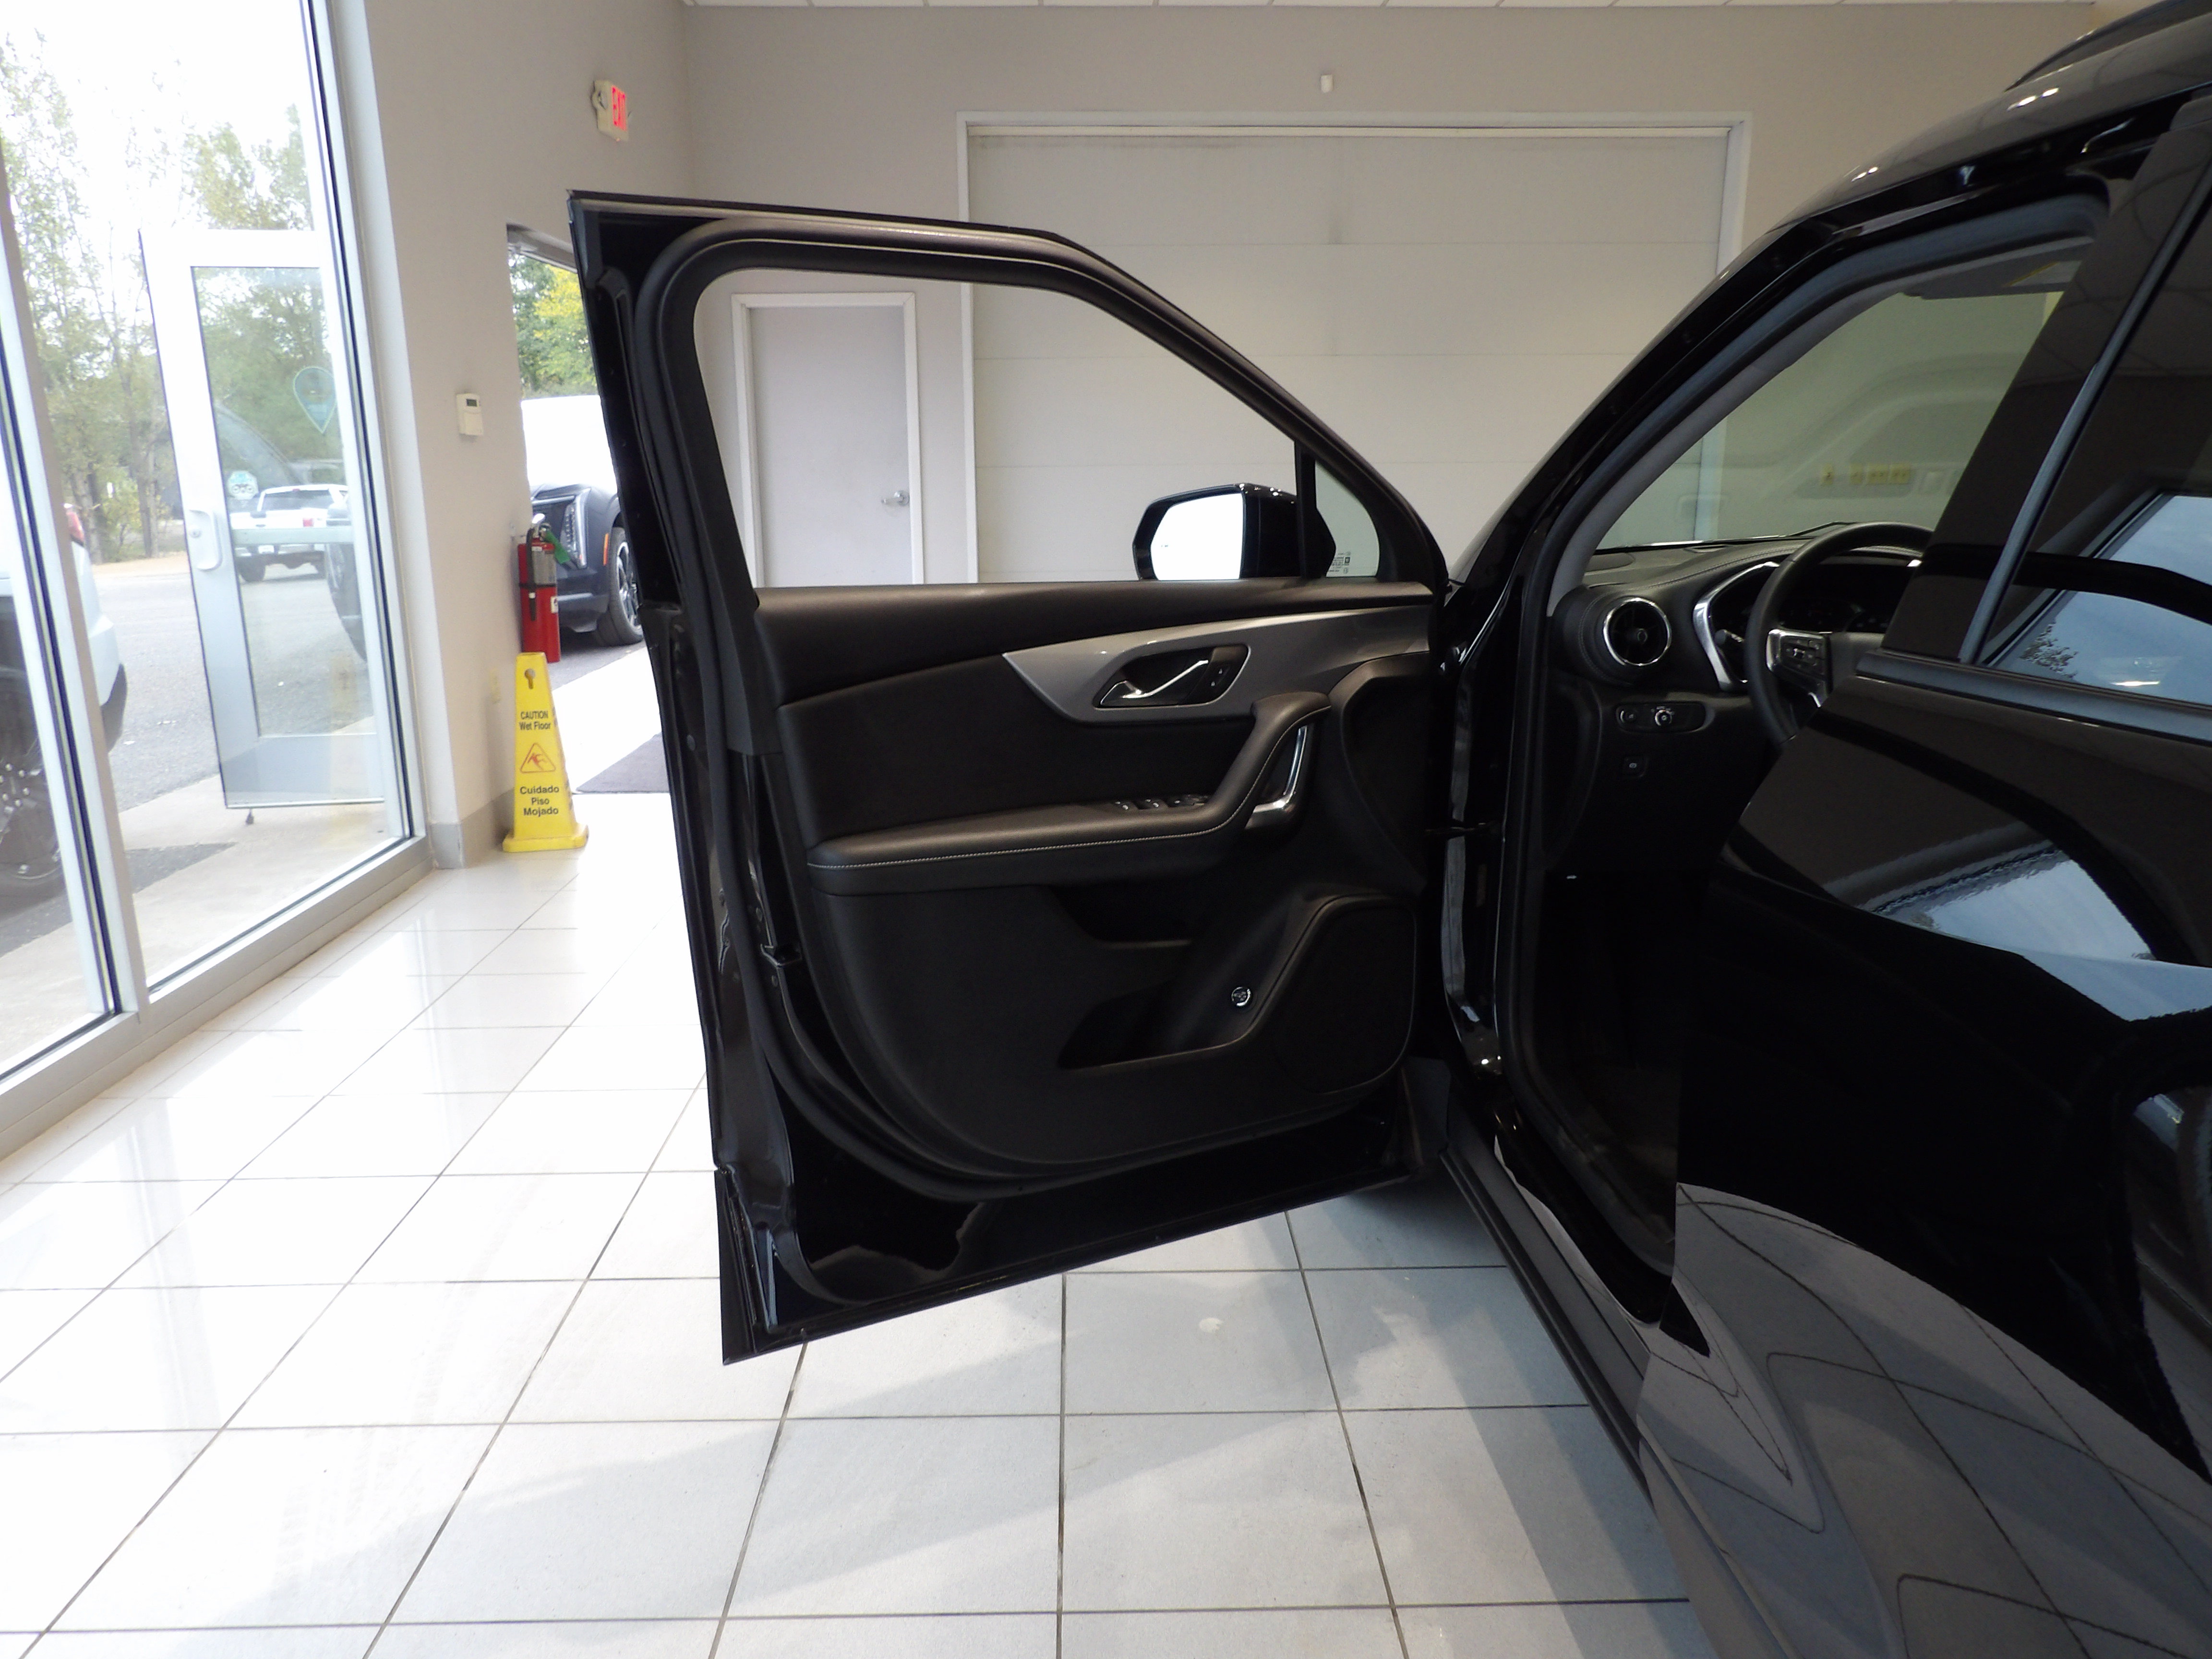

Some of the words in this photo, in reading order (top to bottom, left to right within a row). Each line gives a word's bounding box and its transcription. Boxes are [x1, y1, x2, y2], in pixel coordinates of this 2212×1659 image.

[521, 710, 548, 720] CAUTION
[519, 721, 532, 730] Wet
[534, 721, 551, 730] Floor
[520, 785, 559, 794] Cuidado
[531, 797, 550, 805] Piso
[524, 806, 559, 817] Mojado
